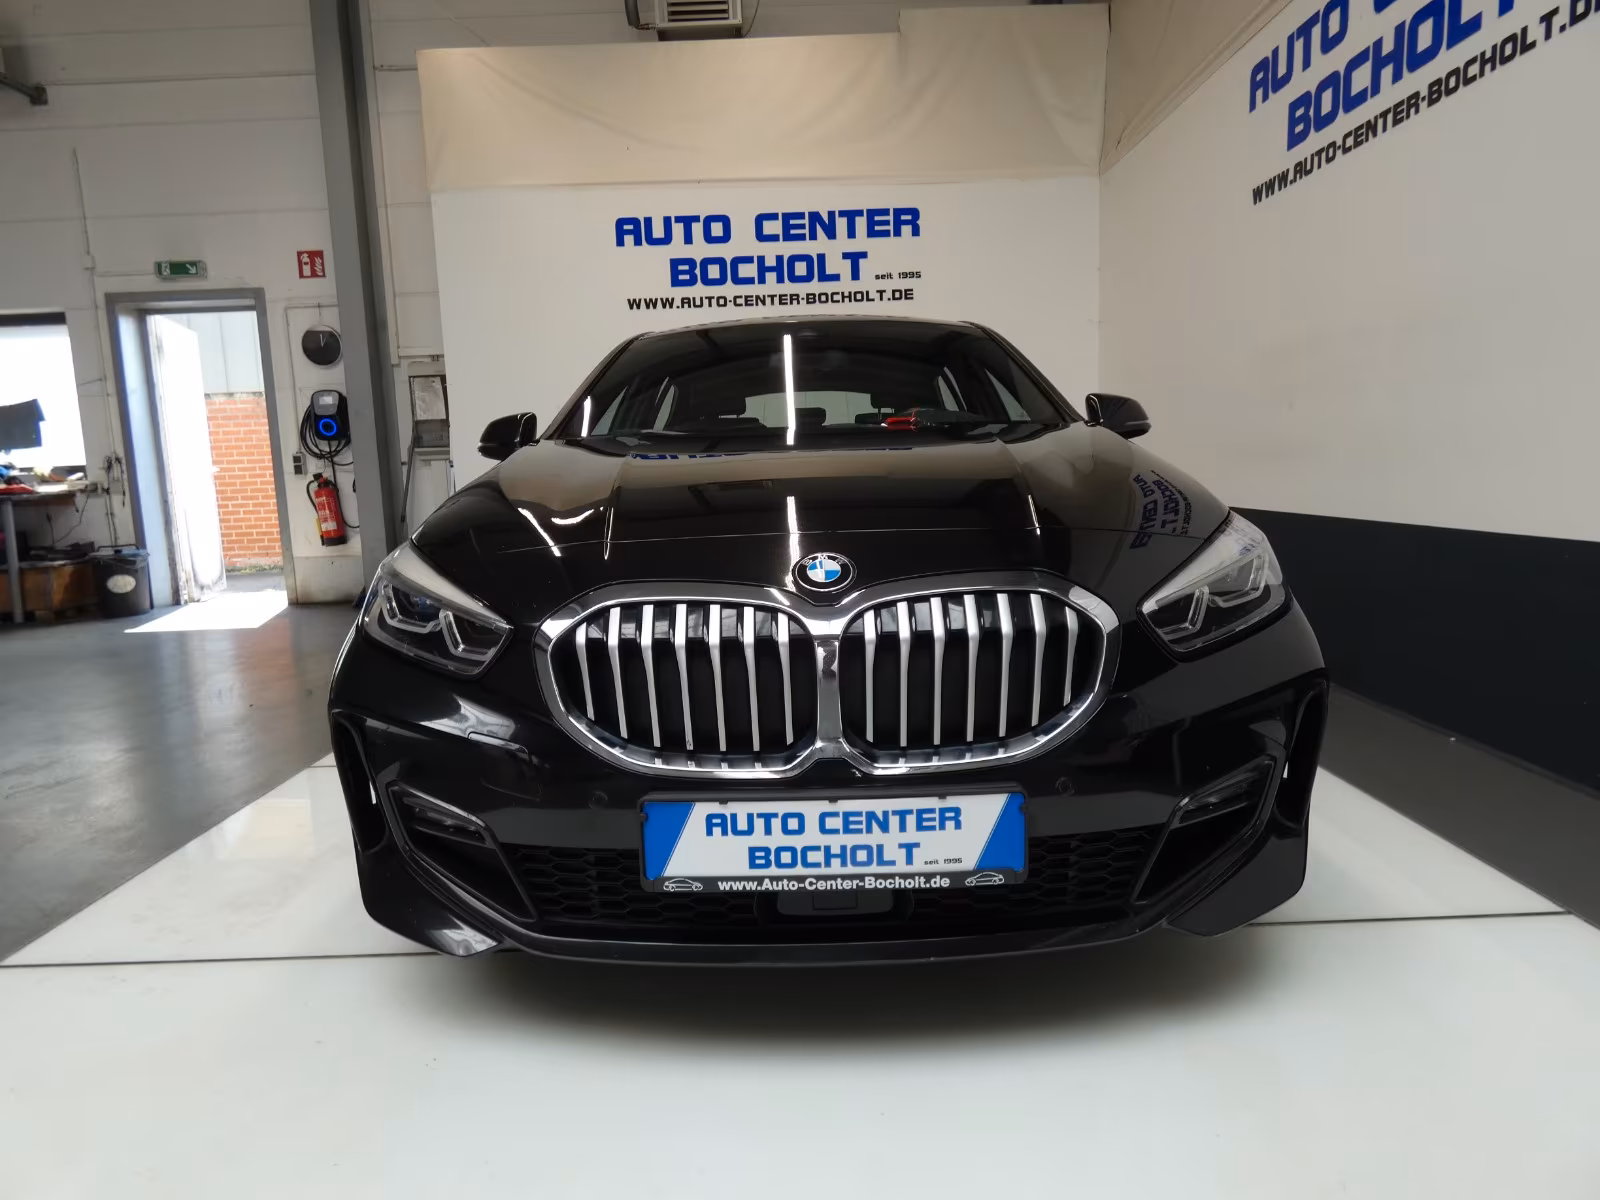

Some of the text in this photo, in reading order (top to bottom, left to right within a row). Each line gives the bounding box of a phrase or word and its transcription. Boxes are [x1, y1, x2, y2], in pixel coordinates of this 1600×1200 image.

[1249, 0, 1349, 113] AUTO
[1287, 0, 1515, 152] BOCHOL
[1252, 0, 1600, 206] WWW.AUTO-CENTER-BOCHOLT.D
[615, 207, 920, 247] AUTO CENTER
[669, 251, 922, 288] BOCHOLT seit 1995
[627, 288, 914, 310] WWW.AUTO-CENTER-BOCHOLT.DE
[705, 807, 962, 836] AUTO CENTER
[748, 842, 920, 870] BOCHOLT
[924, 858, 939, 866] seit
[718, 875, 950, 892] www.Auto-Center-Bocholt.de
